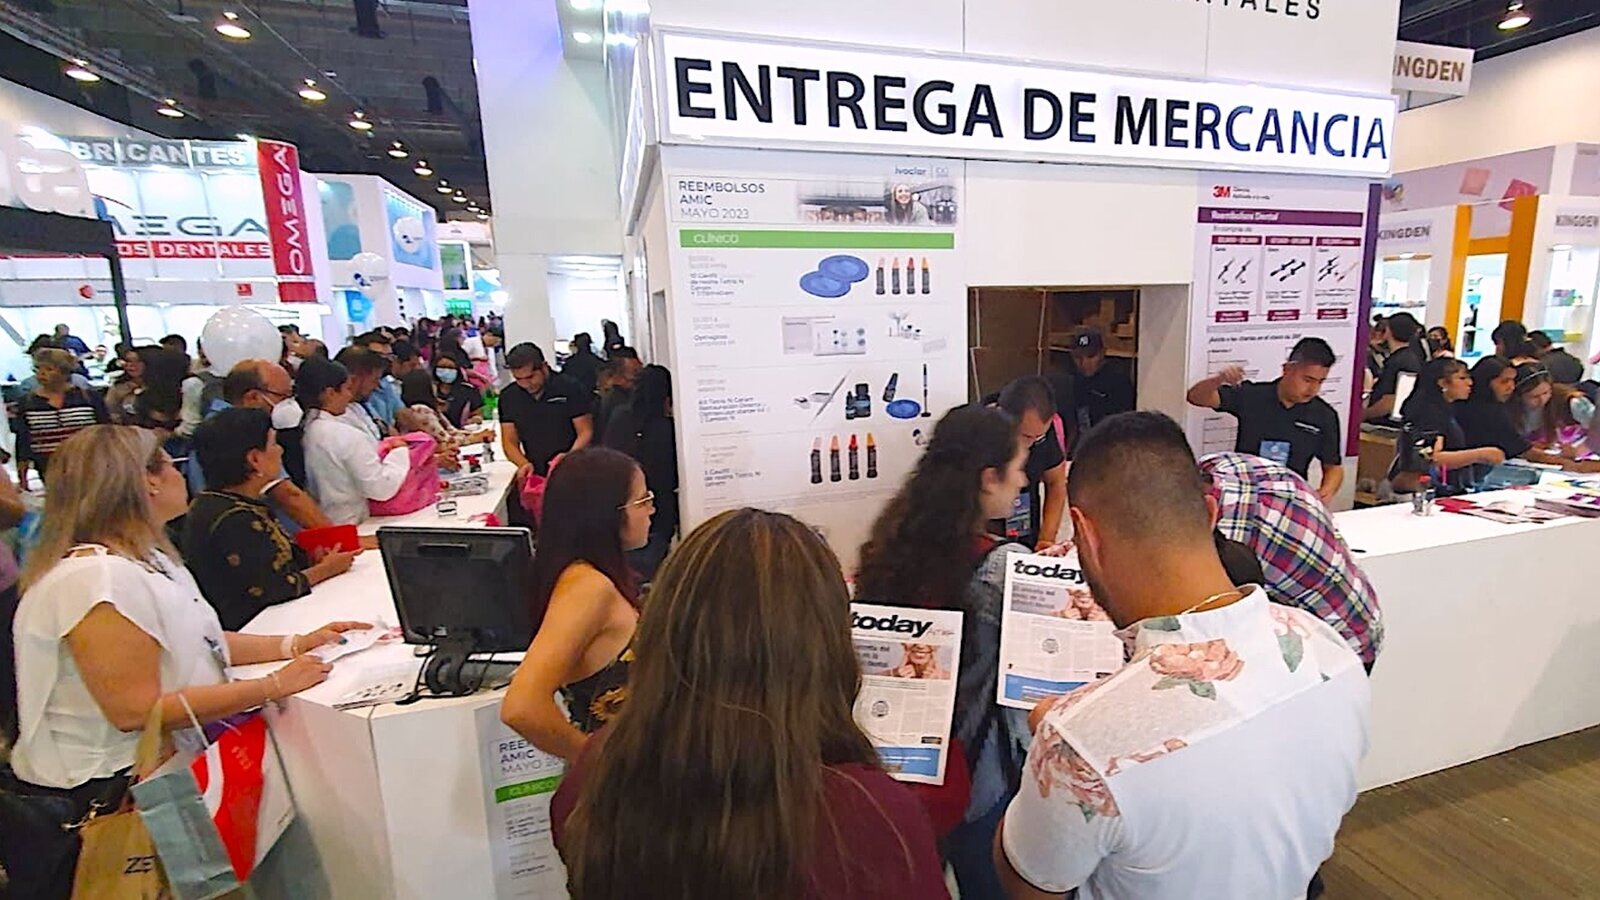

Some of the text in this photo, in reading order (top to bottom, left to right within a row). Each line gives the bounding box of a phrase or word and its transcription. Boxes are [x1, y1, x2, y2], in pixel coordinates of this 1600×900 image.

[675, 56, 1387, 160] ENTREGA DE MERCANCIA
[894, 165, 926, 175] ivoclar
[678, 180, 765, 193] REEMBOLSOS
[1212, 185, 1230, 198] 3M
[680, 195, 713, 205] AMIC
[273, 145, 304, 274] OMEGA
[681, 208, 749, 219] MAYO 2023
[160, 243, 271, 257] DENTALES
[499, 738, 529, 753] REE
[500, 749, 535, 764] AMIC
